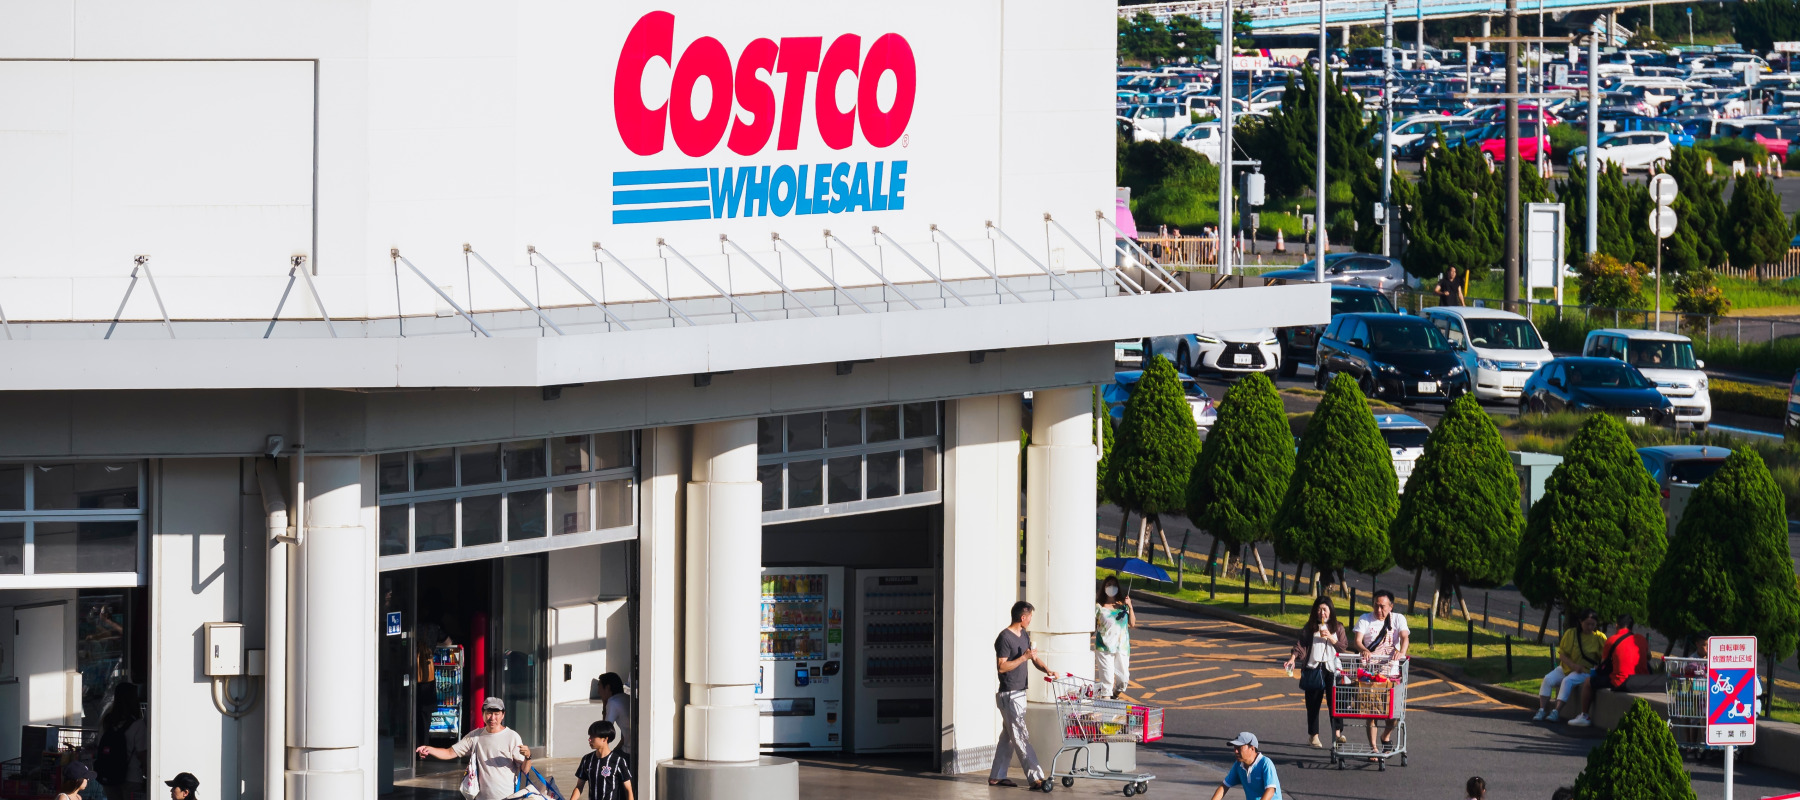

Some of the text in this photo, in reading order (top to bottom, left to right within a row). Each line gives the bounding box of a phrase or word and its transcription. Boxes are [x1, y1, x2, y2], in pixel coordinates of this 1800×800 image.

[1239, 58, 1262, 68] G H
[613, 10, 917, 158] COSTCO
[709, 160, 908, 219] WHOLESALE
[1719, 643, 1746, 652] 自転車等
[1712, 654, 1752, 663] 放置禁止区域
[1715, 730, 1747, 738] 千葉市
